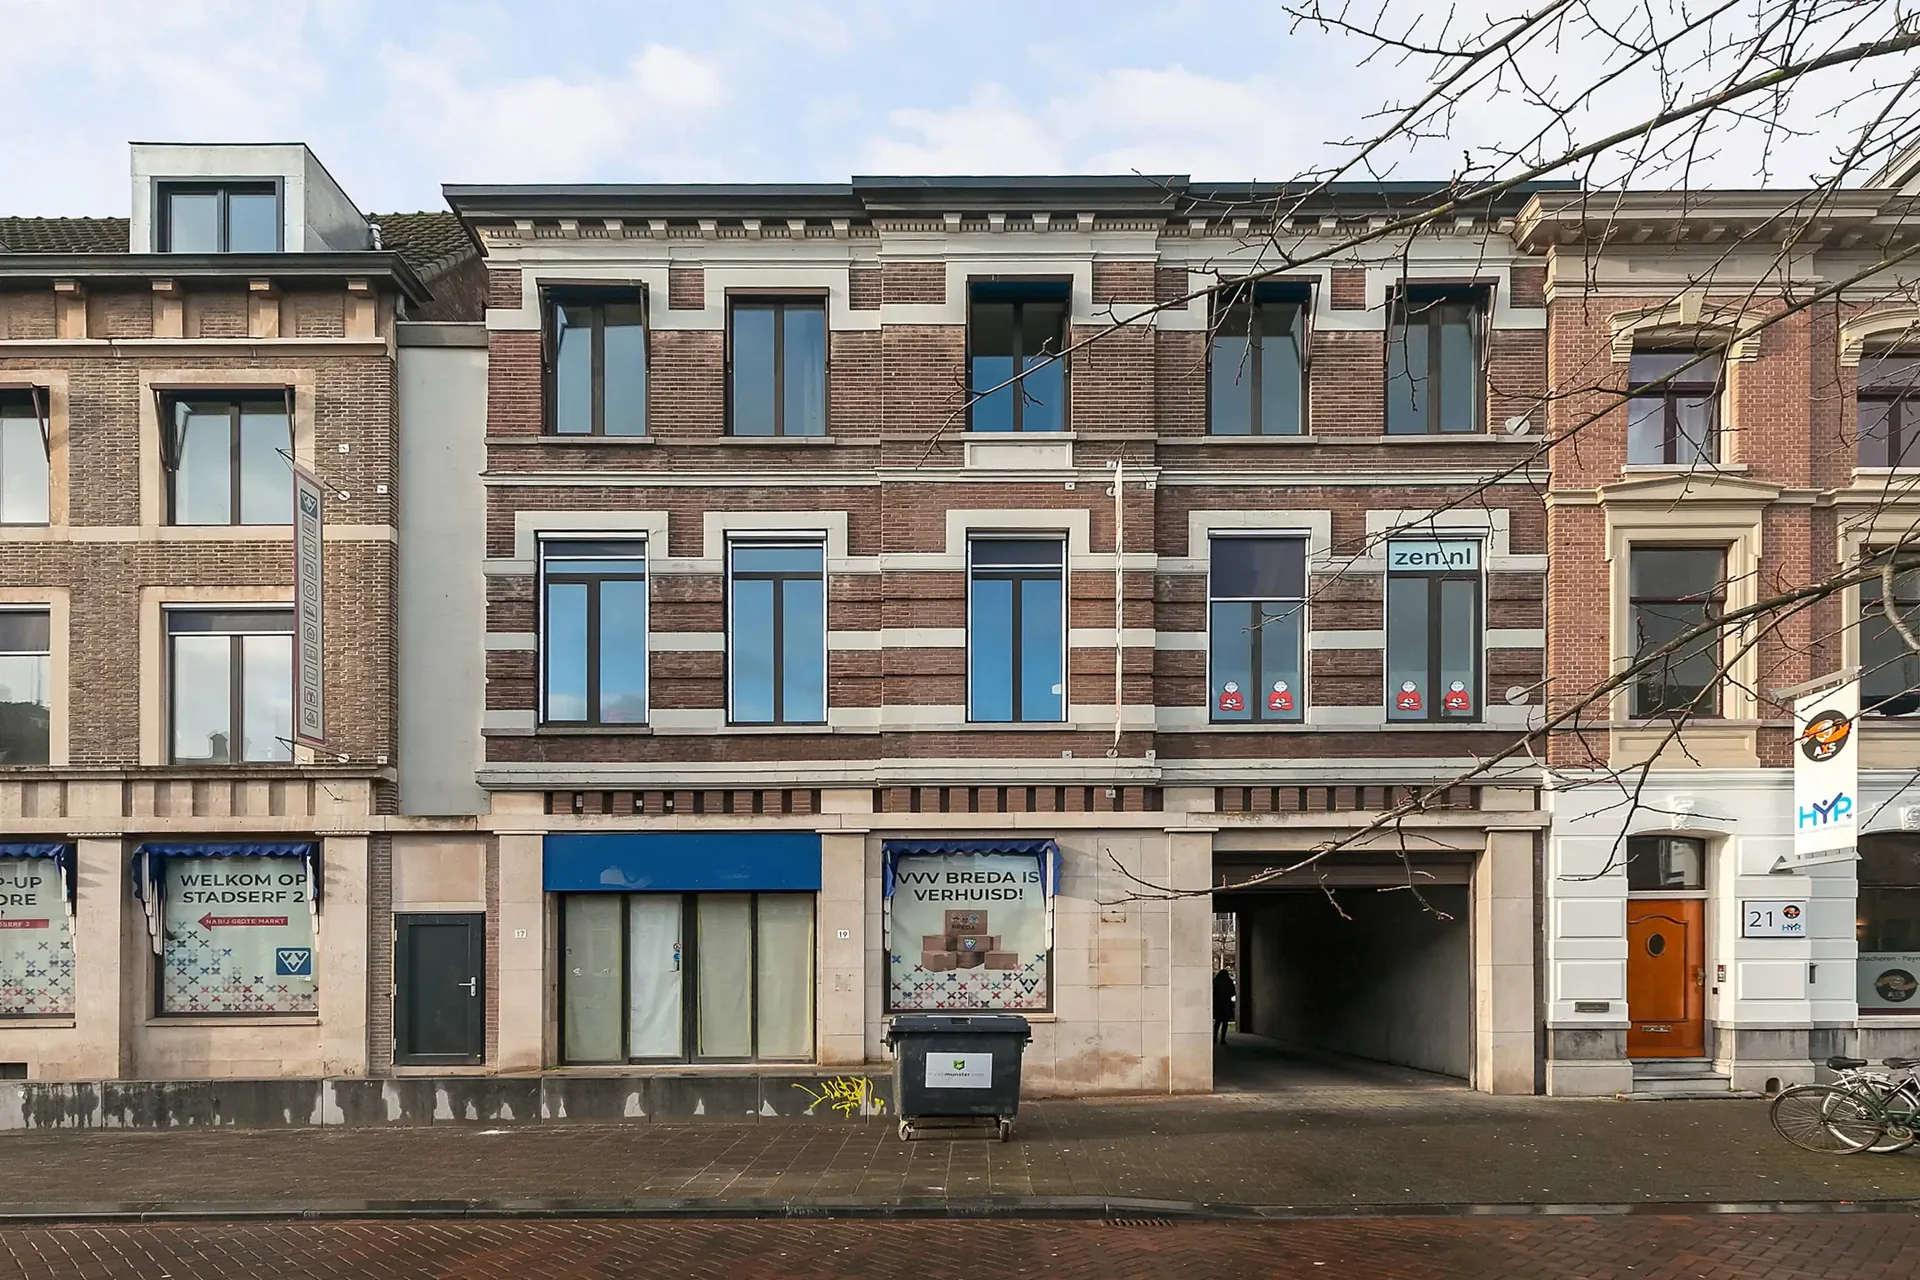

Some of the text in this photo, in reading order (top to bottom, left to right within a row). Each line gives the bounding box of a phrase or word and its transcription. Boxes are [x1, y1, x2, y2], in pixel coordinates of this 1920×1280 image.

[1395, 548, 1470, 565] zen.nl
[1814, 743, 1837, 757] AXS
[1799, 792, 1852, 828] HYP
[180, 874, 307, 886] WELKOM OP
[897, 871, 1039, 884] VVV BREDA IS
[183, 891, 304, 903] STADSERF 2
[914, 888, 1023, 901] VERHUISD!
[1749, 911, 1773, 927] 21
[516, 930, 525, 938] 17
